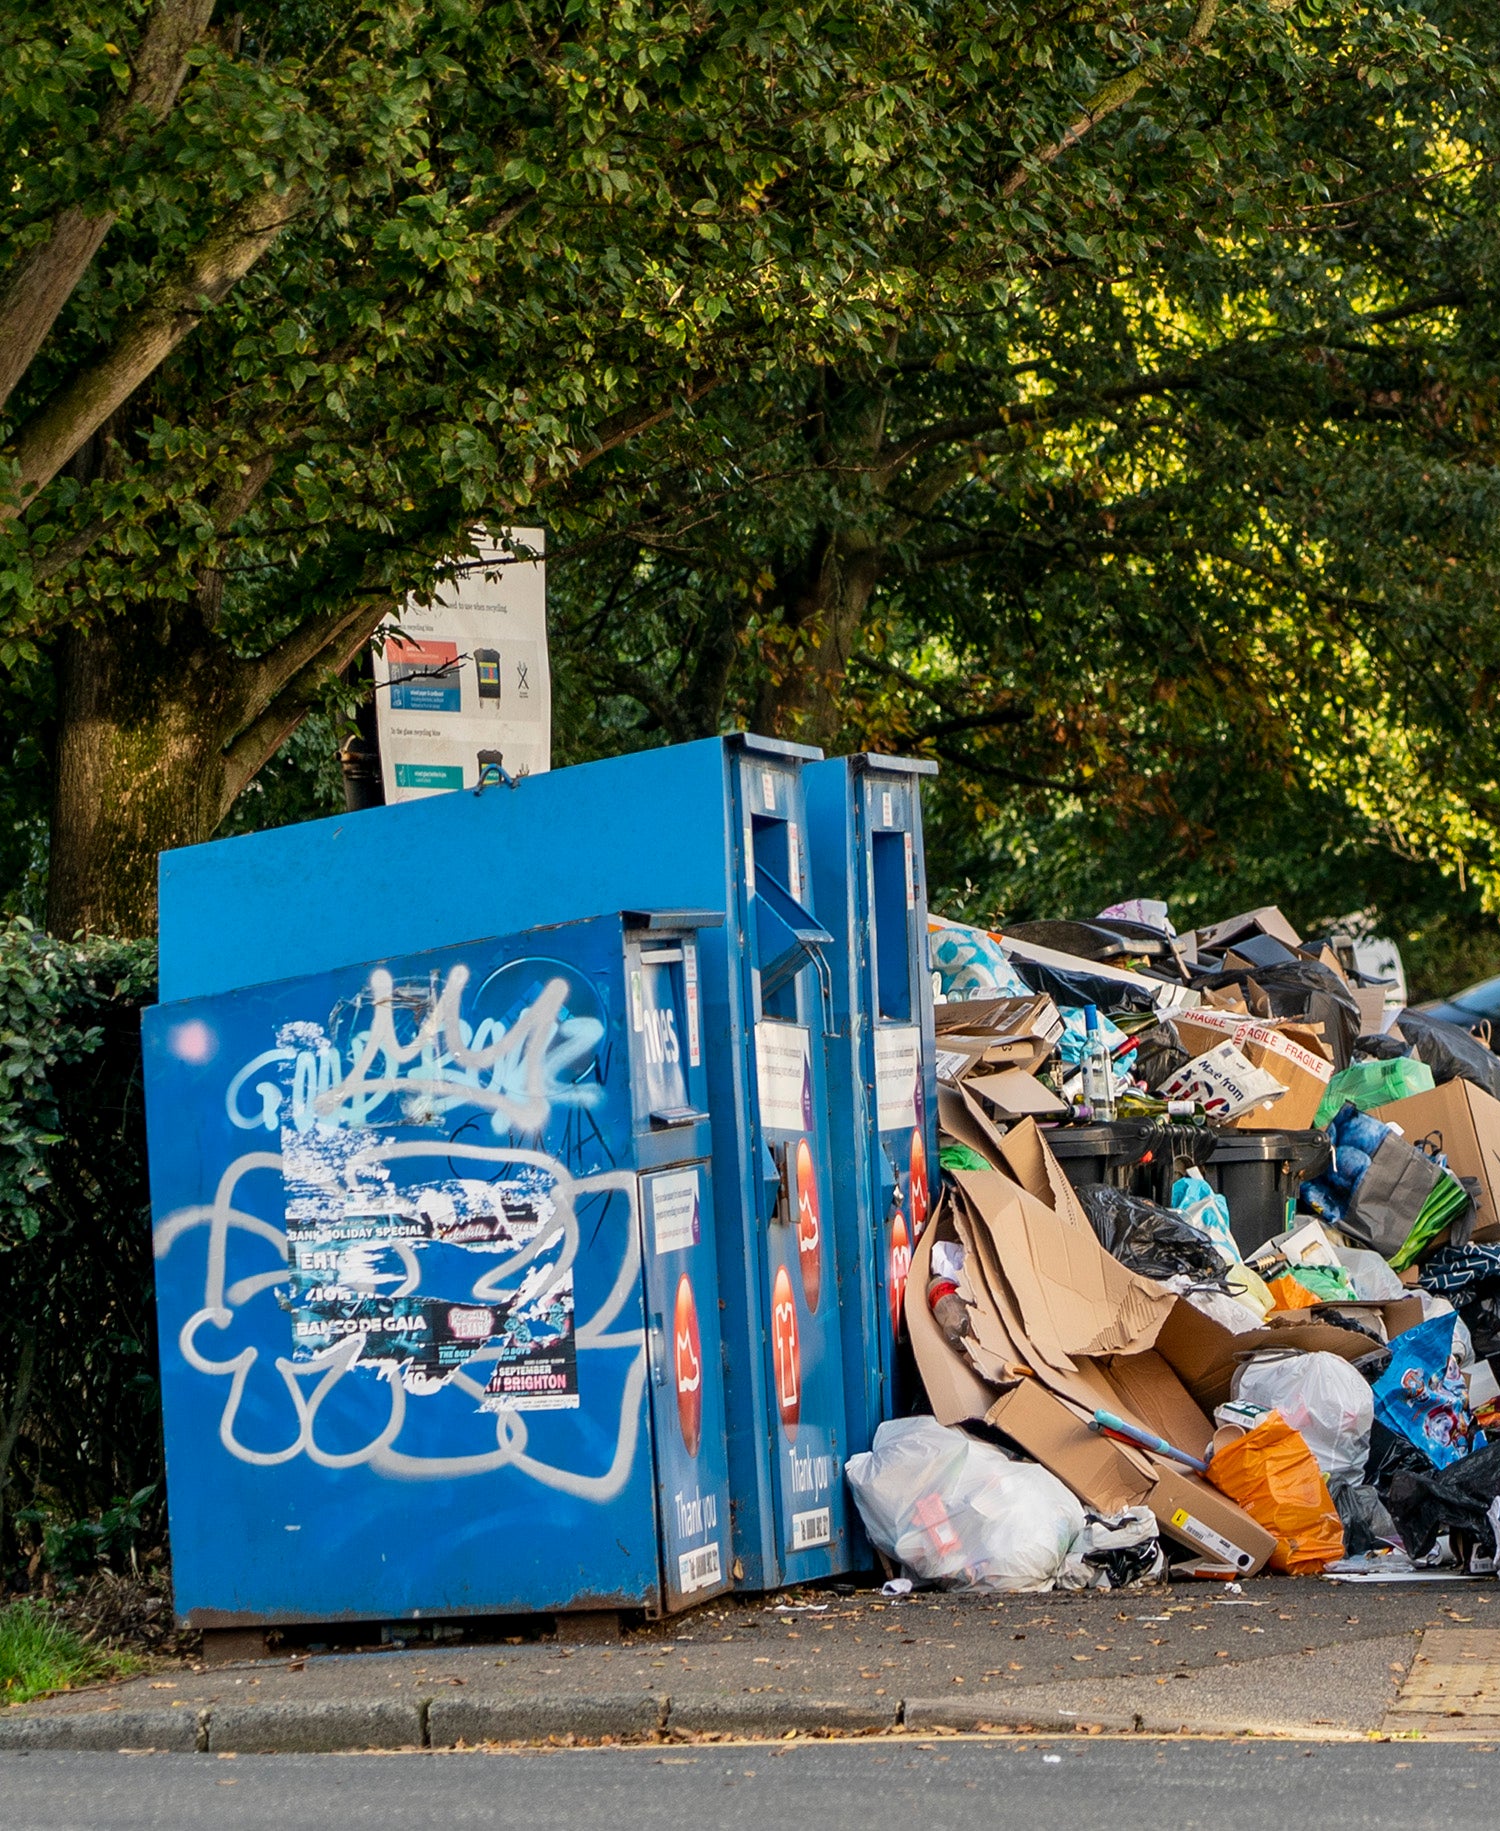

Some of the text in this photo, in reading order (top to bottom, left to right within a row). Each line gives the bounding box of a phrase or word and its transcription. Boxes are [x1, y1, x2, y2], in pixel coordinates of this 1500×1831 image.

[1284, 1043, 1324, 1074] FRAGILE
[1220, 1077, 1244, 1102] from
[375, 1225, 425, 1237] SPECIAL
[296, 1315, 427, 1336] BANCO DE GAIA
[439, 1351, 453, 1359] THE
[454, 1350, 470, 1358] BOX
[511, 1347, 532, 1355] BOYS
[498, 1364, 552, 1377] SEPTEMBER
[503, 1374, 567, 1391] BRIGHTON
[788, 1444, 828, 1502] Thank you
[675, 1485, 717, 1544] Thank you
